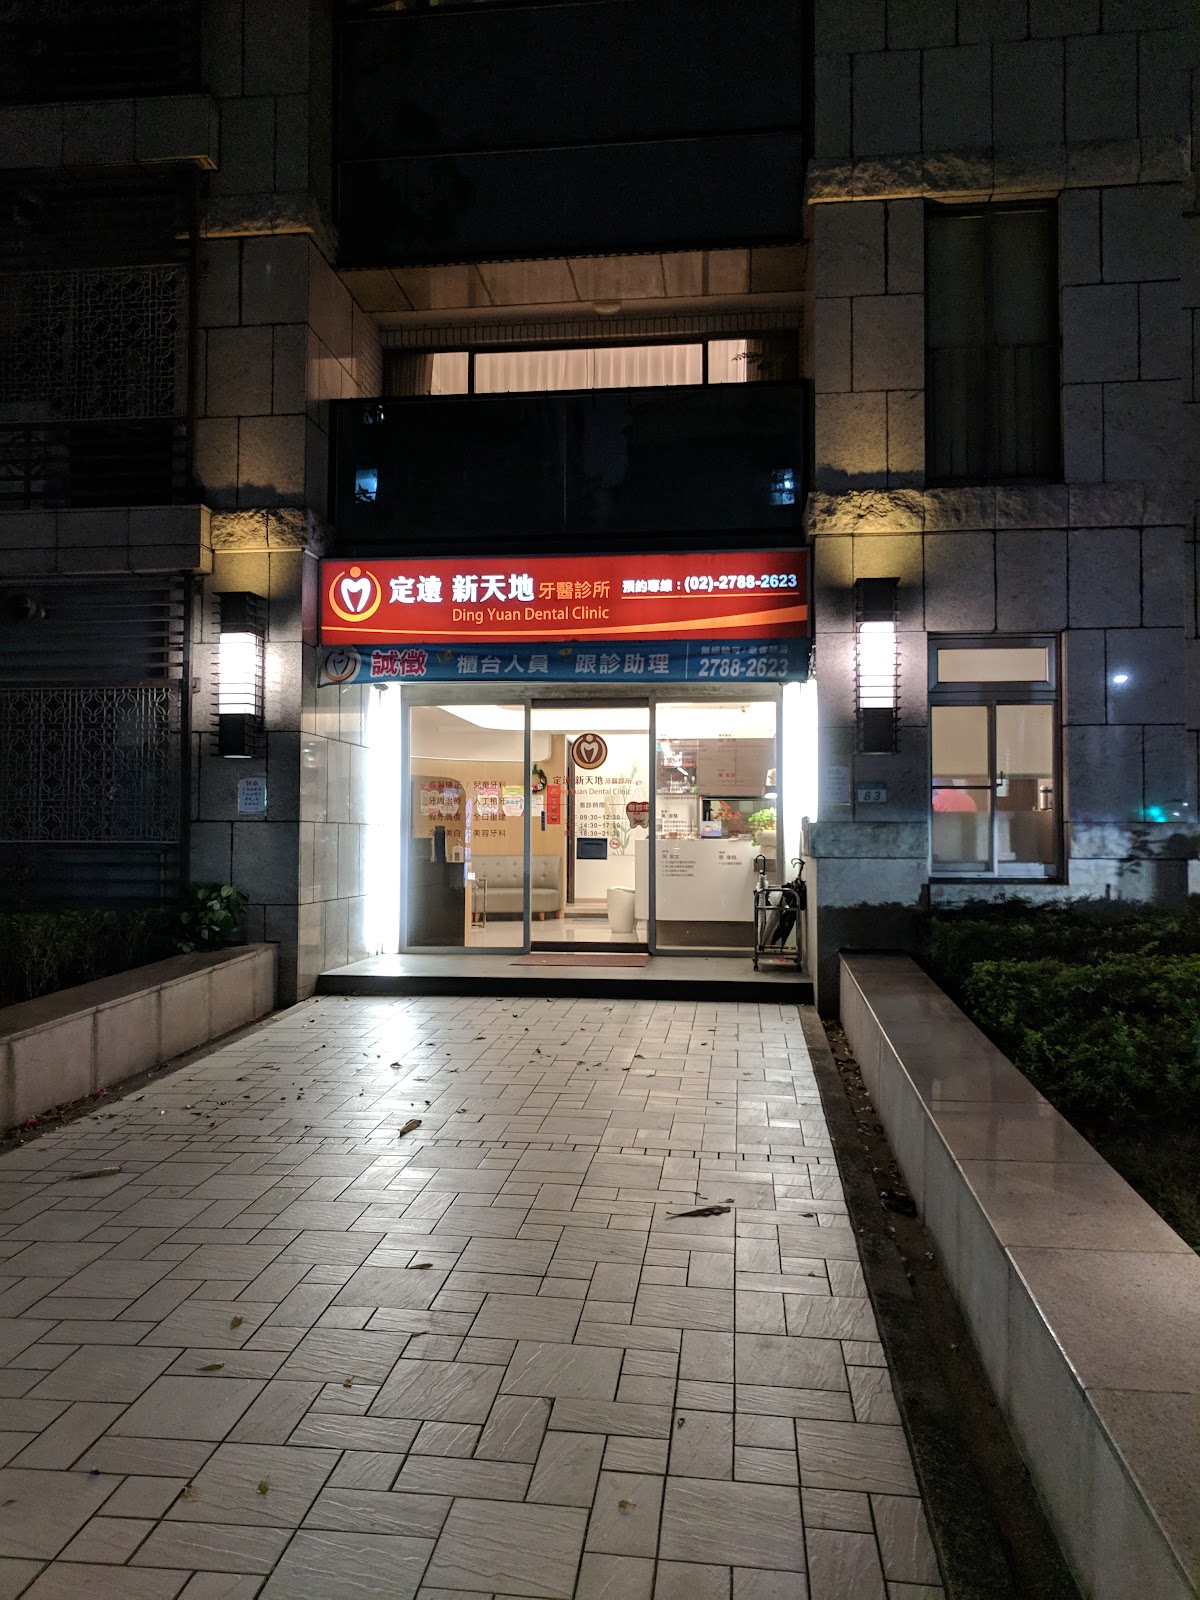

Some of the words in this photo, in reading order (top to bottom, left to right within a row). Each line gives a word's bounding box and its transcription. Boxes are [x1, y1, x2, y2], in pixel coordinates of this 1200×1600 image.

[389, 575, 443, 604] 定遠
[452, 573, 534, 603] 新天地
[538, 580, 610, 600] 牙醫診所
[684, 574, 797, 592] (02)-2788-2623
[452, 608, 484, 624] Ding
[487, 607, 521, 621] Yuan
[524, 606, 569, 621] Dental
[572, 605, 609, 620] Clinic
[457, 654, 549, 674] 櫃台人員
[575, 653, 669, 674] 跟診助理
[698, 658, 789, 677] 2788-2623
[575, 776, 603, 785] 新天地
[863, 791, 881, 801] 83
[429, 829, 461, 838] 冷美白
